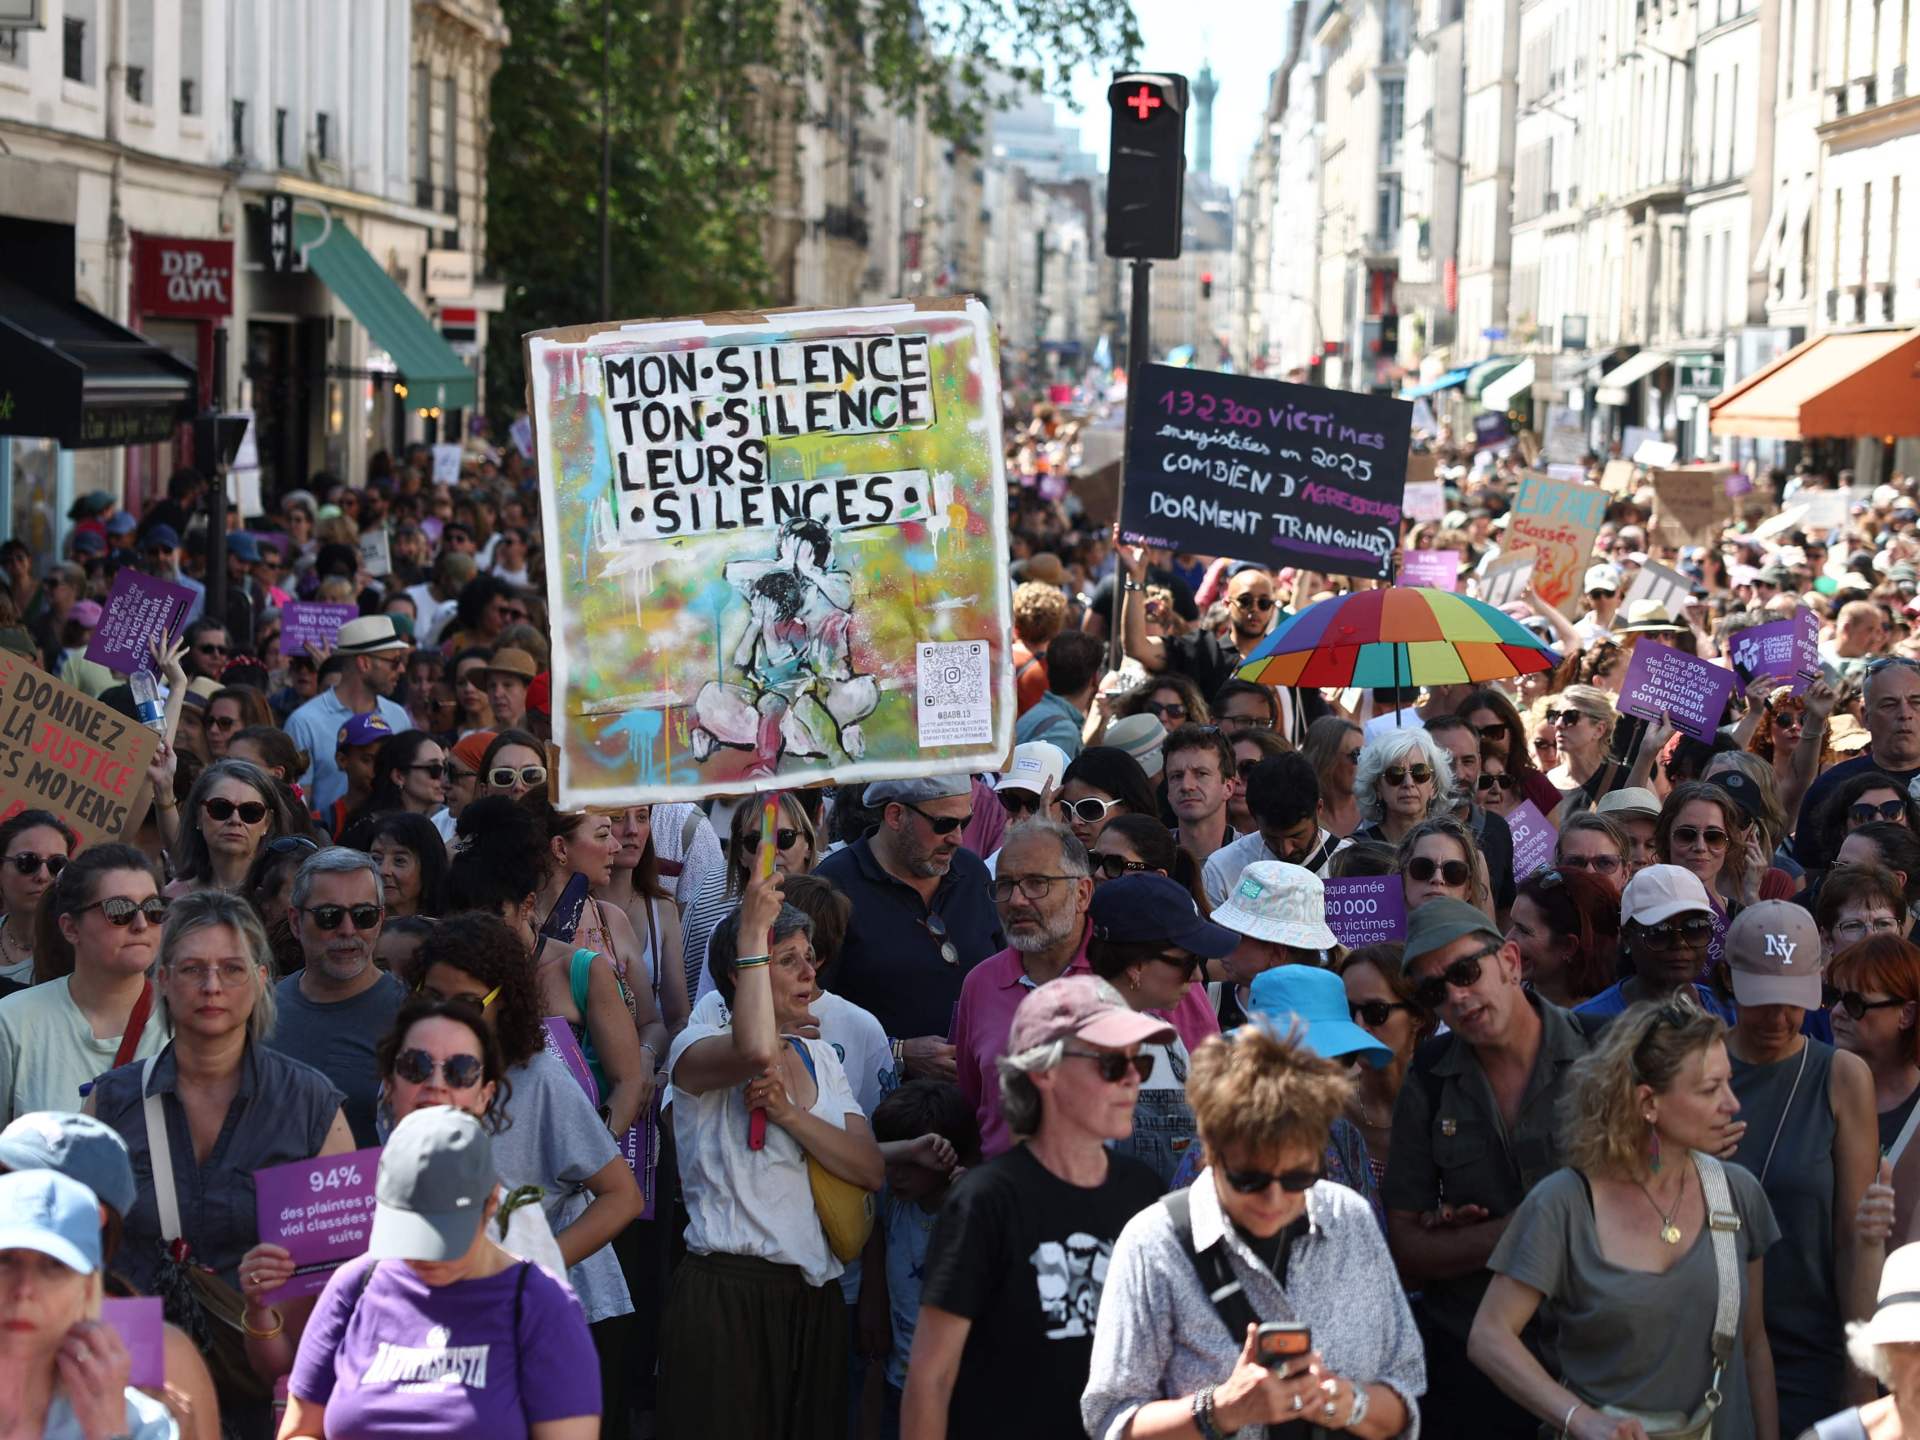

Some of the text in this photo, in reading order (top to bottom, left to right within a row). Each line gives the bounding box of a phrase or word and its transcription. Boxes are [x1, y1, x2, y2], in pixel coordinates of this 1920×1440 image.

[271, 196, 287, 272] PNY
[617, 440, 768, 492] LEURS
[1280, 448, 1302, 461] en
[1310, 447, 1373, 482] 2025
[1149, 491, 1263, 536] DORMENT
[109, 595, 124, 615] 90%
[121, 598, 151, 650] la victime
[131, 597, 162, 660] connaissait
[137, 594, 175, 671] son gresseur
[1645, 656, 1720, 690] des cas de viol ou
[1646, 664, 1685, 684] tentative
[1686, 678, 1698, 689] de
[1663, 653, 1708, 677] Dans 90%
[1641, 683, 1705, 713] connaissait
[1650, 674, 1705, 702] la victime
[13, 671, 126, 752] DONNEZ
[1631, 690, 1653, 704] son
[1654, 698, 1708, 725] agresseur
[2, 704, 134, 797] LA JUSTICE
[24, 760, 128, 834] MOYENS
[1514, 829, 1548, 858] victimes
[1325, 880, 1385, 898] aque année
[1344, 898, 1378, 915] 000
[1343, 916, 1396, 930] victimes
[1764, 933, 1797, 965] NY
[309, 1164, 363, 1193] 94%
[280, 1206, 305, 1221] des
[306, 1198, 362, 1219] plaintes
[280, 1223, 305, 1237] viol
[306, 1212, 367, 1233] classées
[328, 1229, 364, 1245] suite
